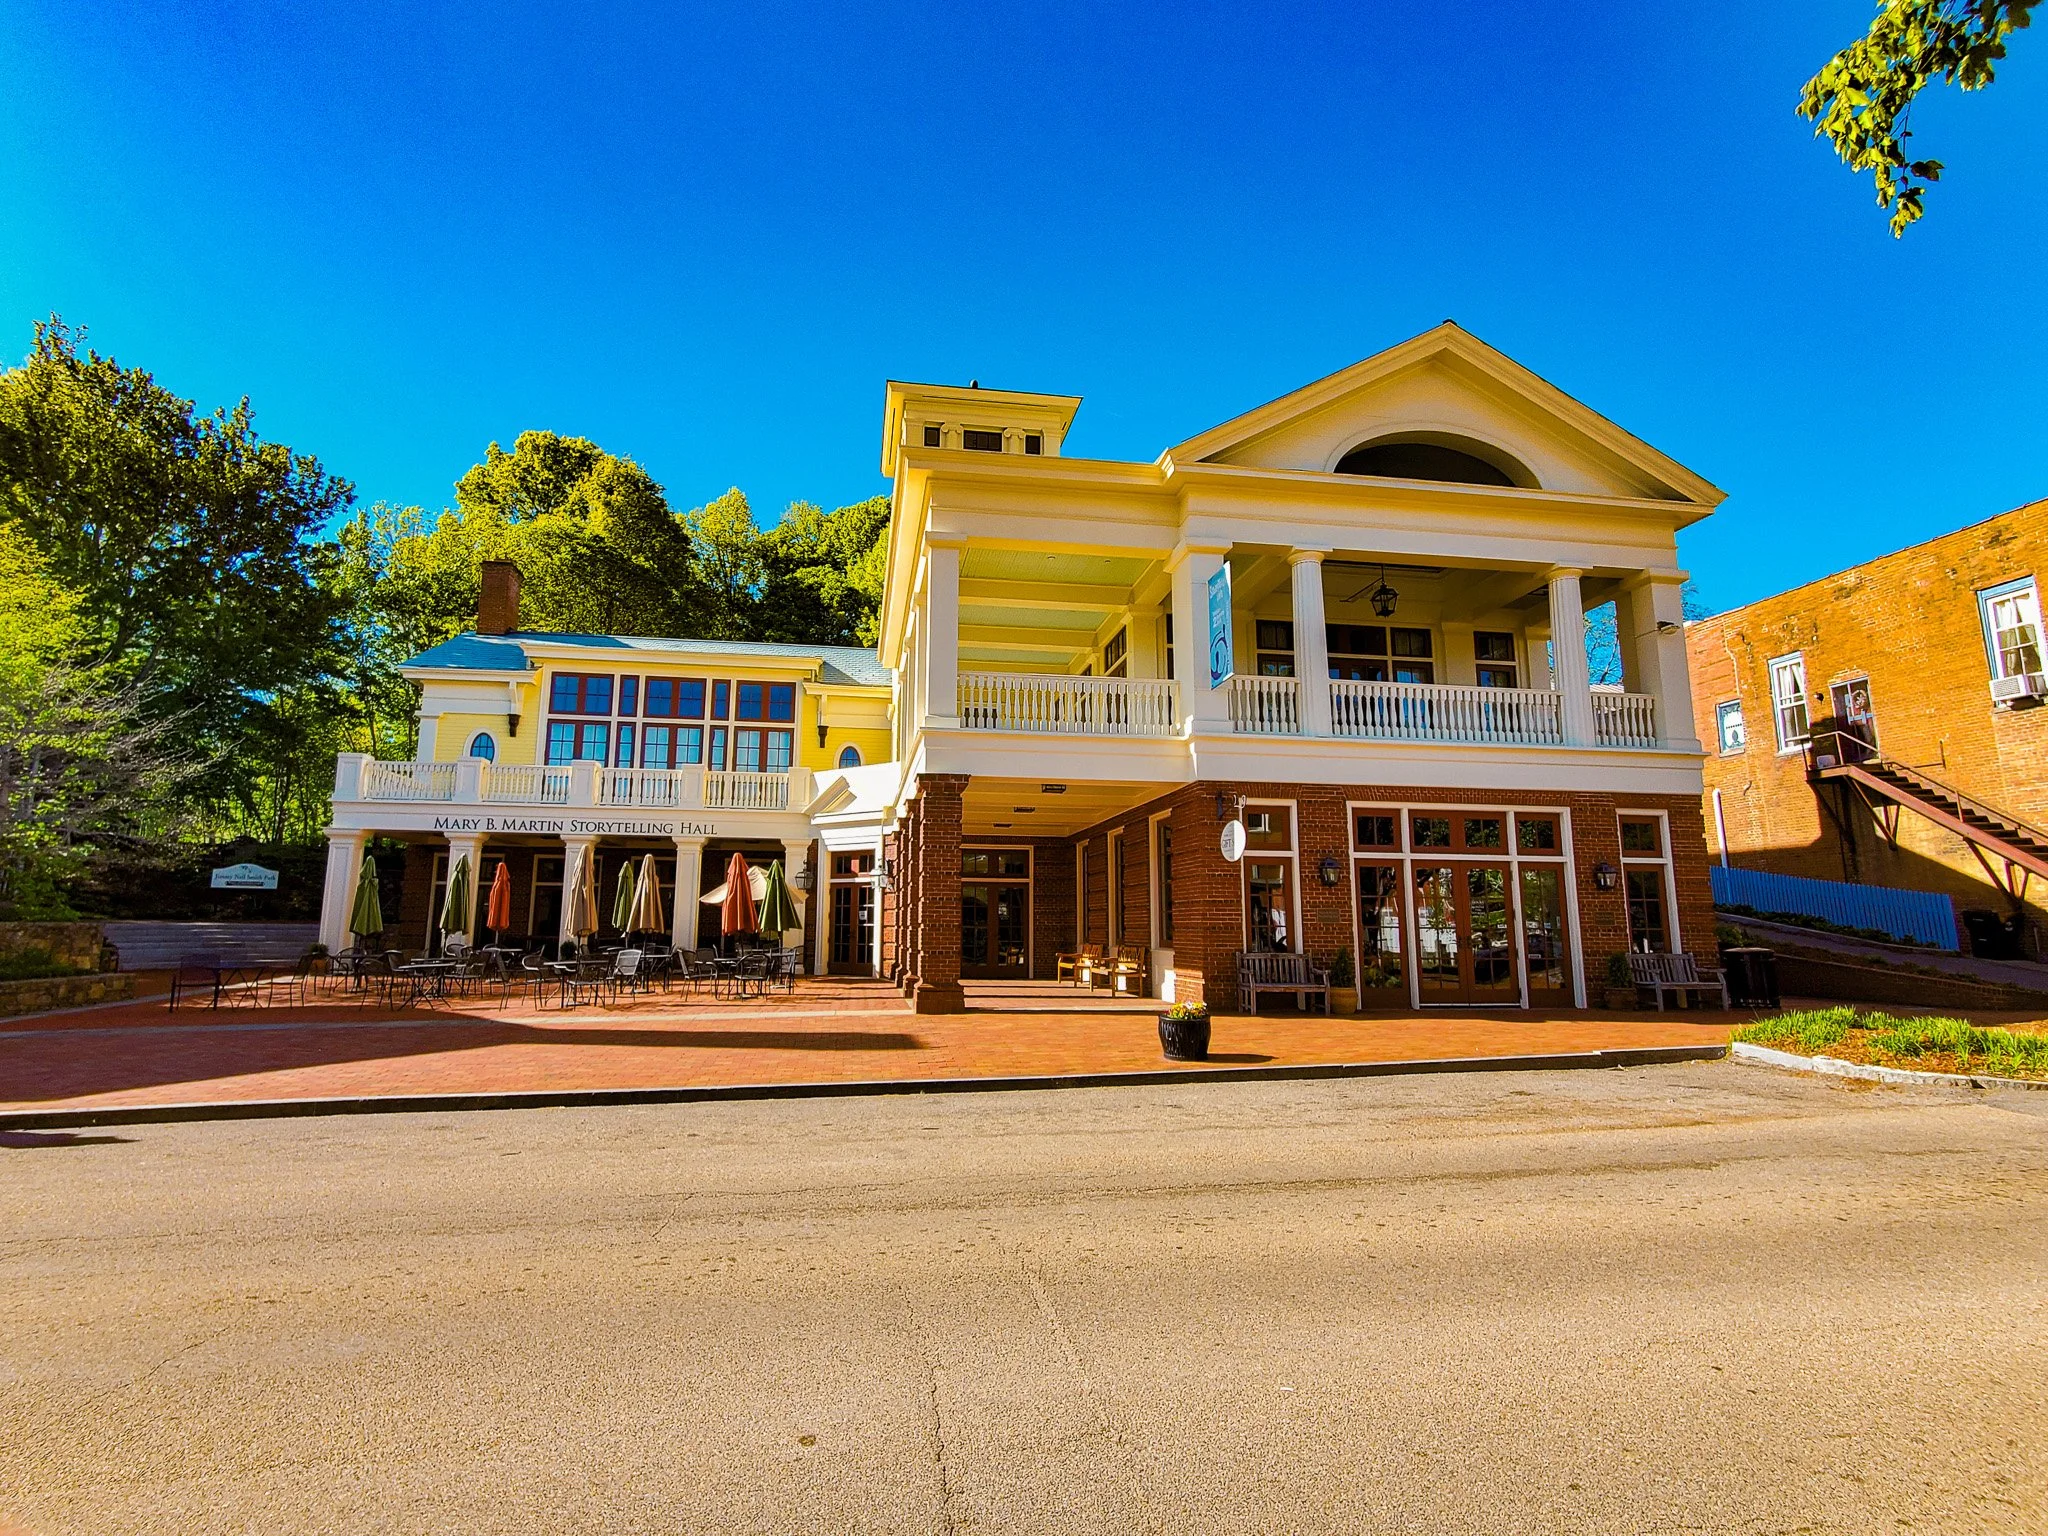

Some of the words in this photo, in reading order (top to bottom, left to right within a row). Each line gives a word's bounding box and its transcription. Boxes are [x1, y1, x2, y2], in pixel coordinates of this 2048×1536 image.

[485, 817, 498, 831] B.
[501, 818, 564, 832] MARTIN
[570, 819, 674, 834] STORYTELLING
[681, 821, 718, 835] HALL
